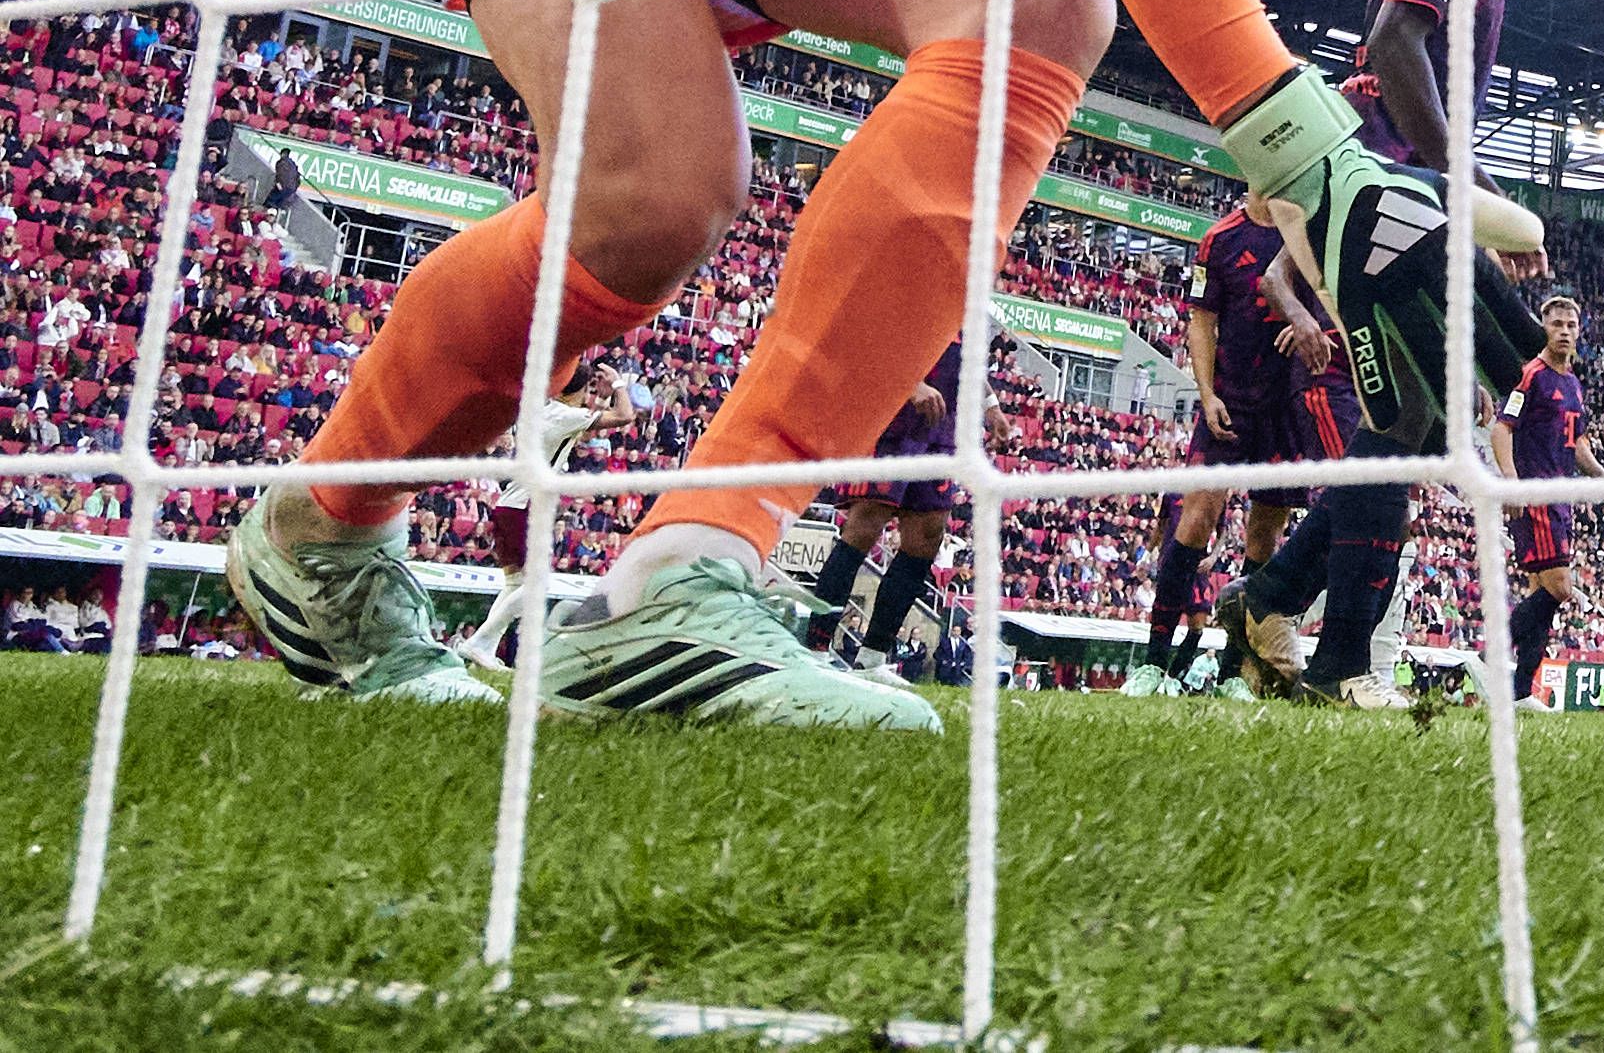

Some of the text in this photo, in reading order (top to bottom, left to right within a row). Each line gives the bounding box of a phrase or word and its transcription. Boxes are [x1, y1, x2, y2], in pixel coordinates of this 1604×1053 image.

[1259, 119, 1293, 147] NEUER
[303, 158, 381, 196] ARENA
[1151, 211, 1193, 233] sonepar
[1351, 326, 1385, 395] PRED
